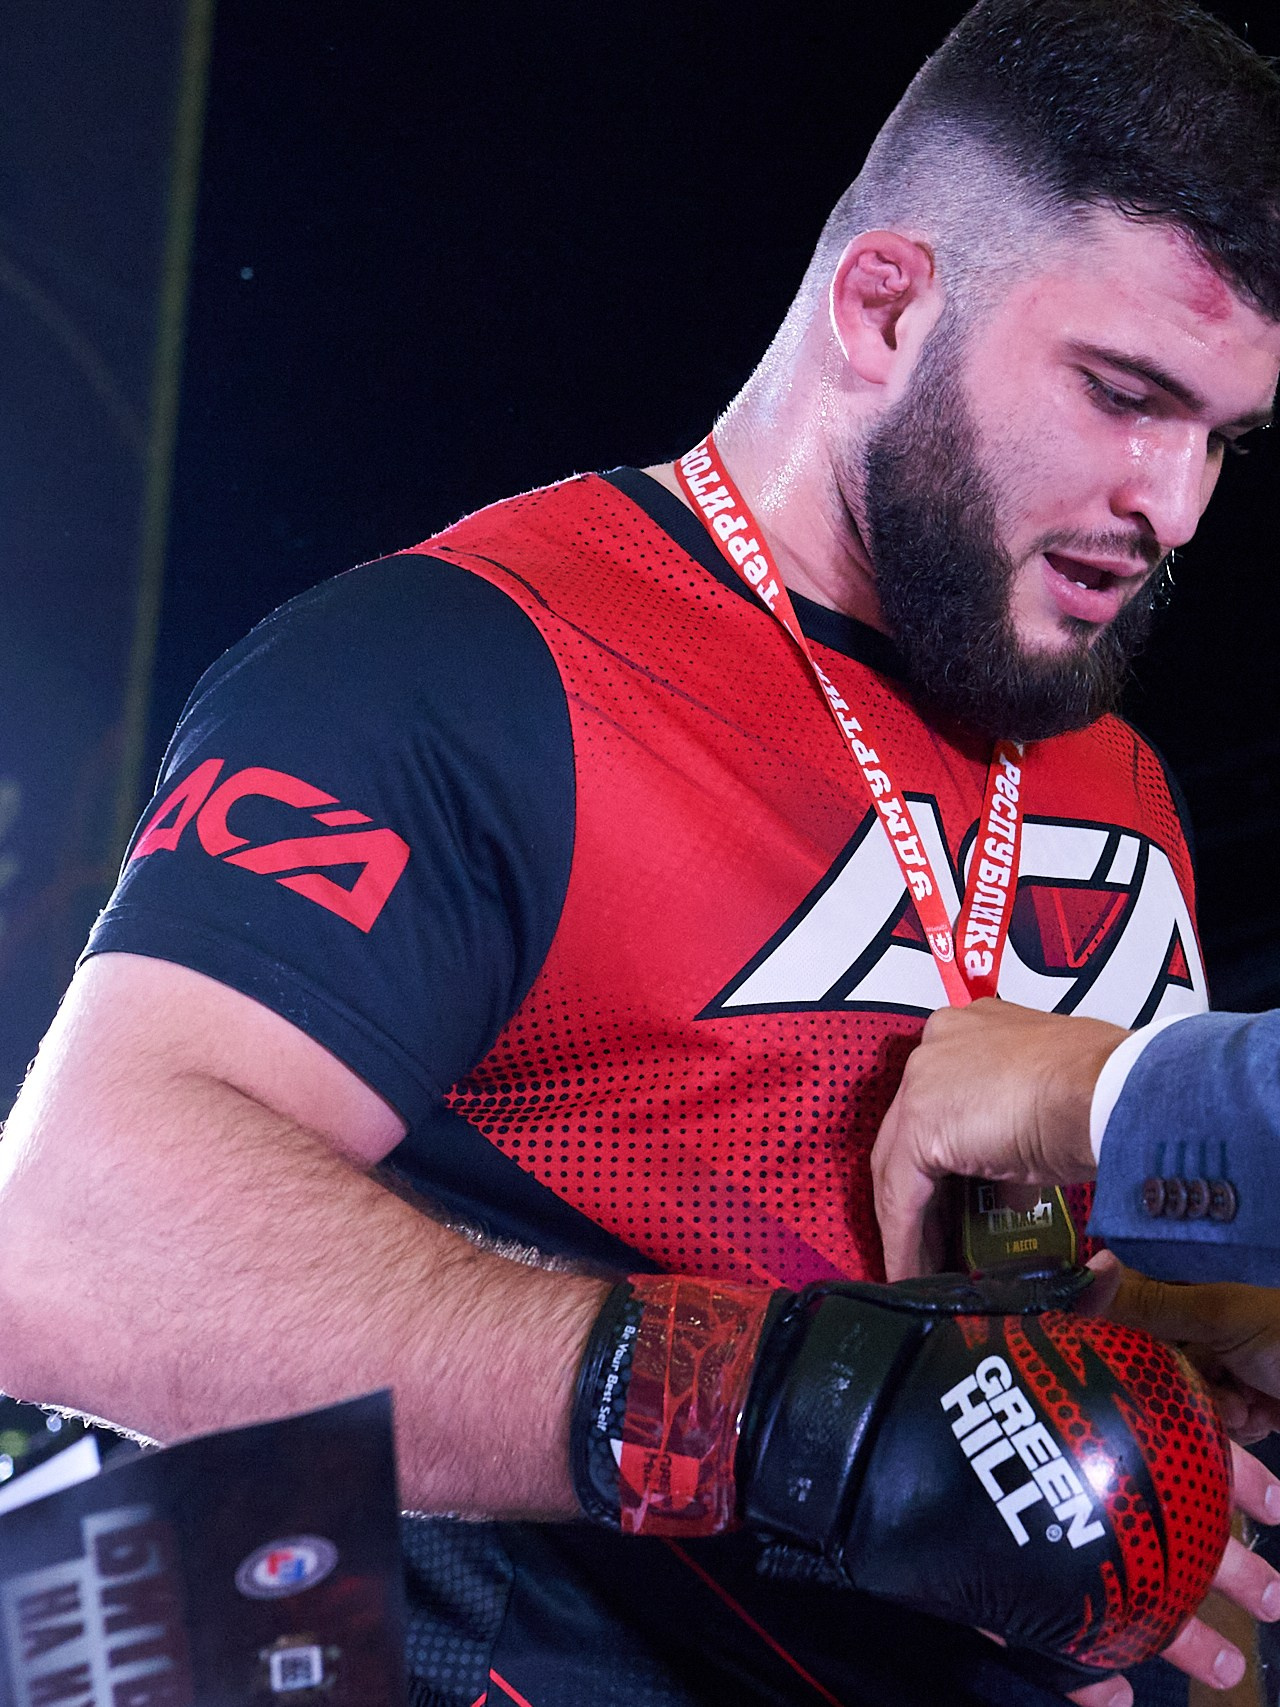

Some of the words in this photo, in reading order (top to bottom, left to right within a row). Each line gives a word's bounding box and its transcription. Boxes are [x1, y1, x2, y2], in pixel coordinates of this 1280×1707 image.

[131, 758, 410, 933] ACA
[622, 1325, 636, 1340] Be
[611, 1343, 629, 1371] Your
[602, 1374, 618, 1403] Best
[597, 1405, 611, 1432] Self
[940, 1374, 1043, 1547] HILL
[976, 1355, 1106, 1549] GREEN
